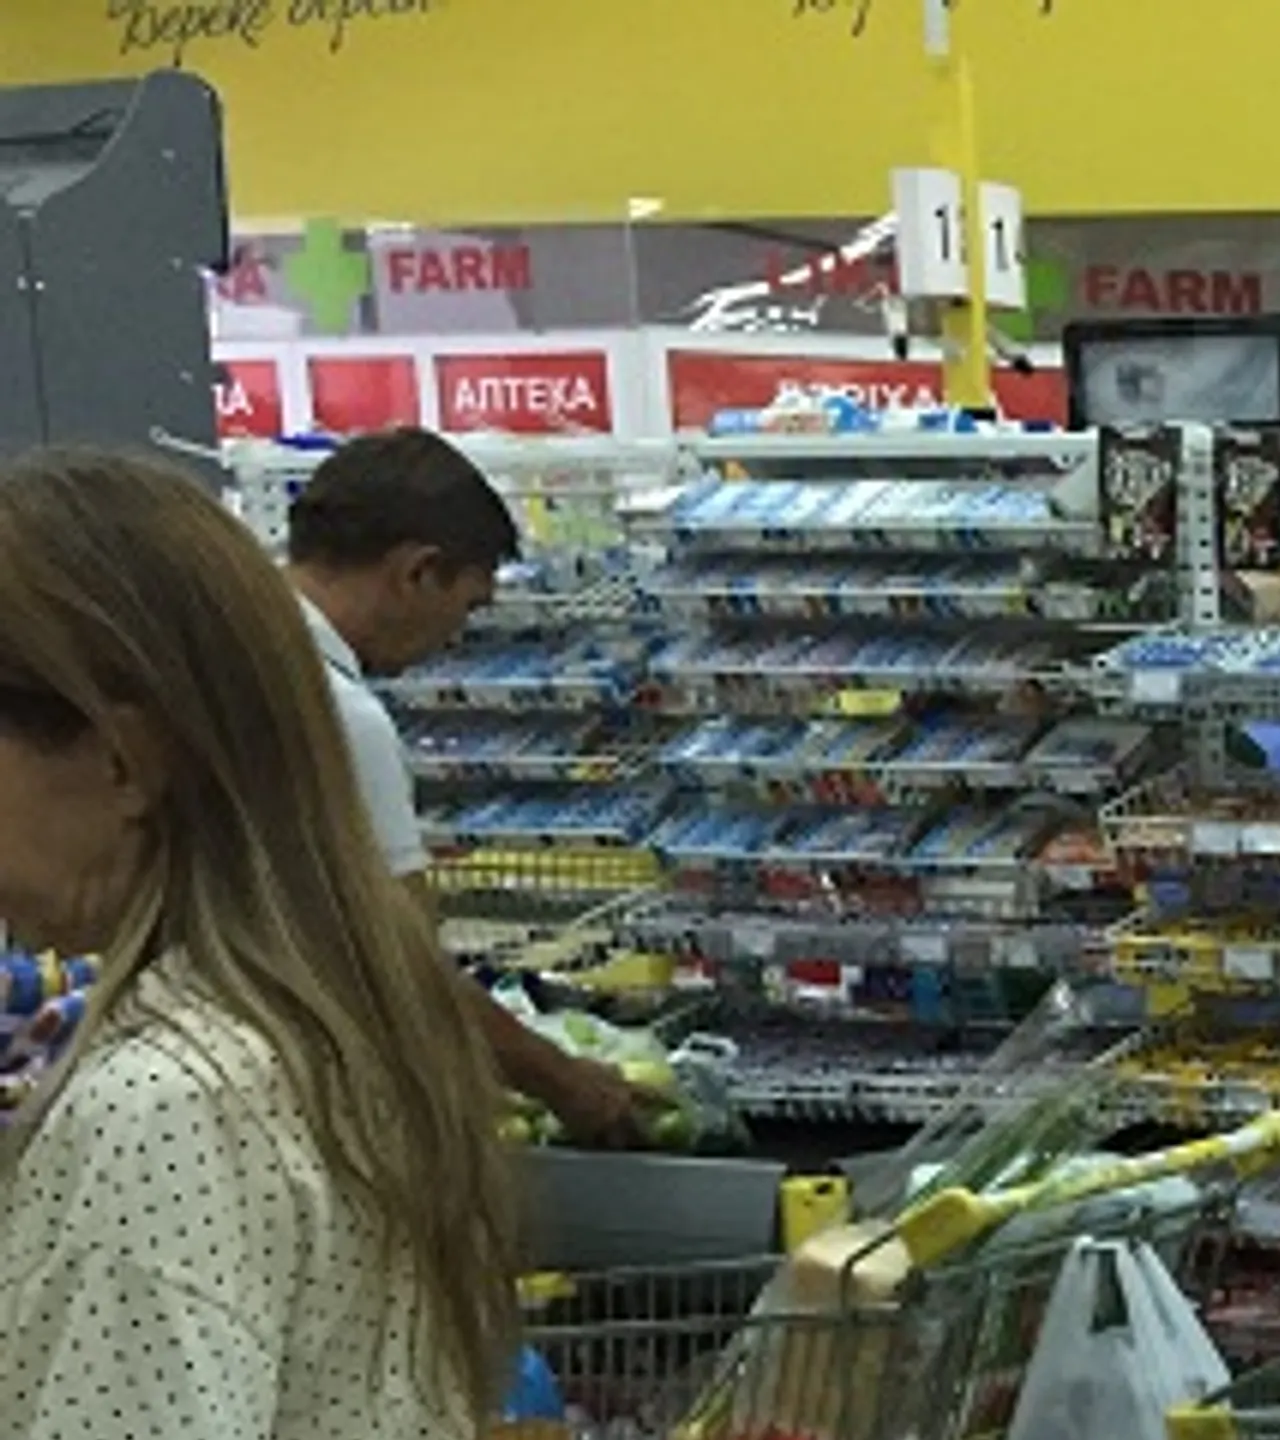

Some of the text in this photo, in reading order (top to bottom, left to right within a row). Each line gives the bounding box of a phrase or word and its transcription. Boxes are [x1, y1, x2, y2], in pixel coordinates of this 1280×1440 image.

[935, 204, 949, 261] 1
[991, 217, 1010, 272] 1
[386, 243, 533, 295] FARM
[1082, 265, 1264, 314] FARM
[454, 376, 597, 413] АПТЕКА
